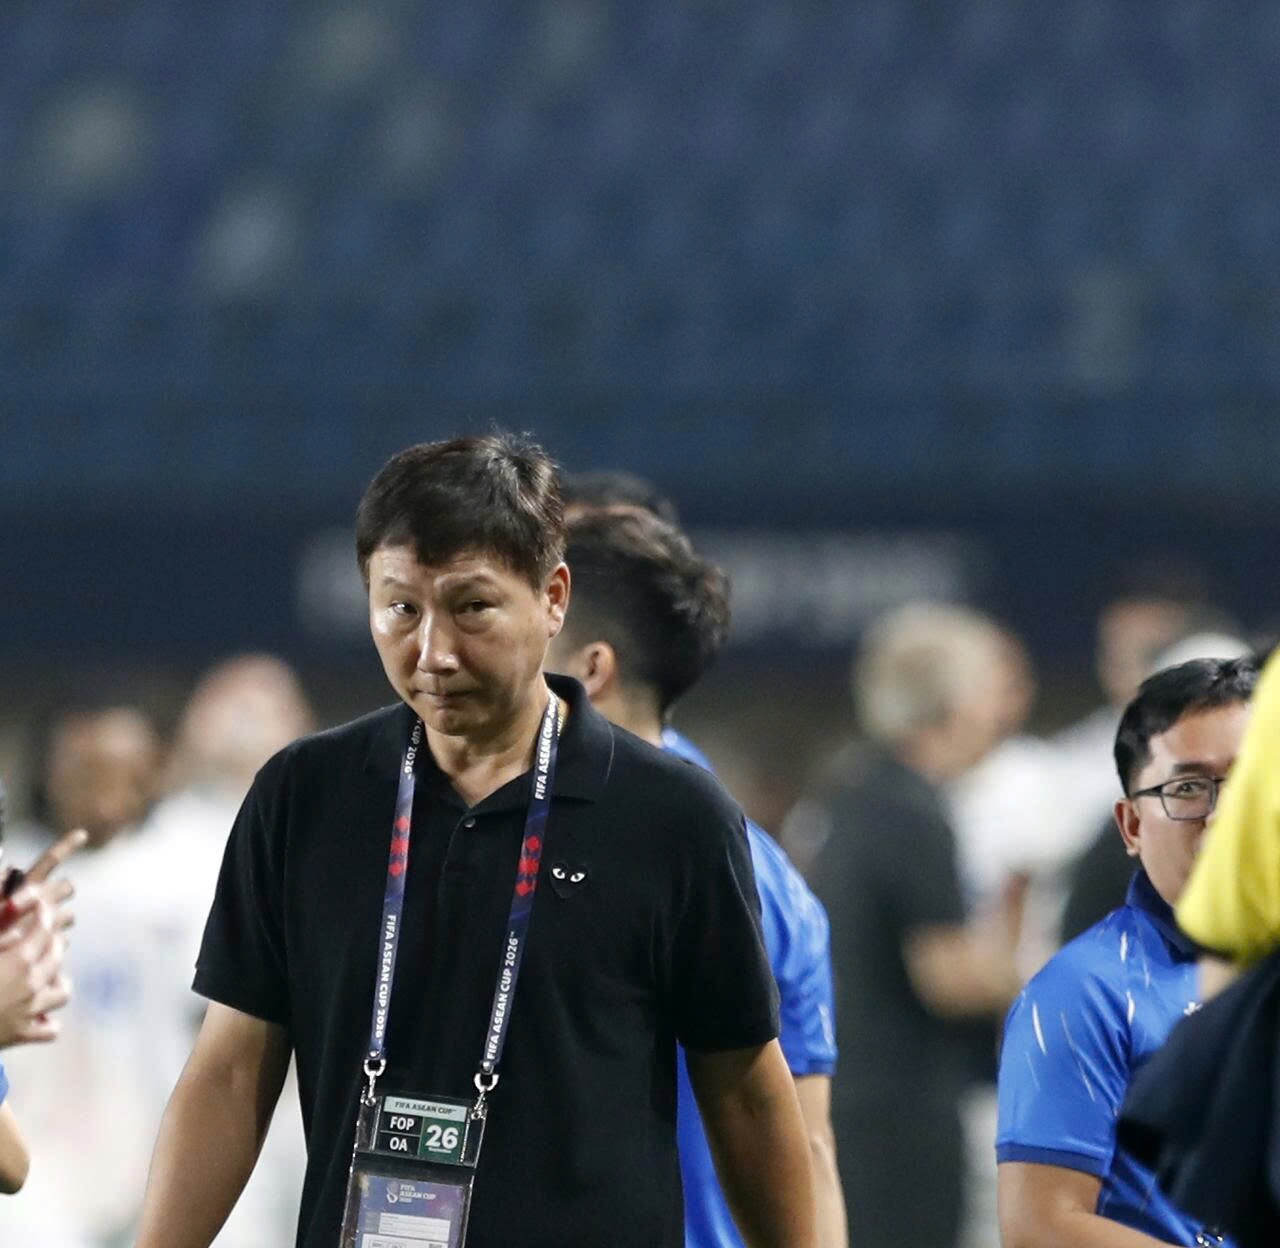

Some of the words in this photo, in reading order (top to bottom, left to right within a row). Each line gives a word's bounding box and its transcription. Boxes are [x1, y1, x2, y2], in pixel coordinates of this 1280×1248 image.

[543, 717, 553, 738] CUP
[538, 737, 551, 773] ASEAN
[535, 775, 547, 800] FIFA
[385, 914, 397, 940] FIFA
[381, 942, 393, 982] ASEAN
[500, 968, 512, 992] CUP
[379, 983, 388, 1008] CUP
[493, 993, 508, 1033] ASEAN
[487, 1035, 499, 1060] FIFA
[395, 1102, 410, 1110] FIFA
[411, 1103, 437, 1113] ASEAN
[390, 1116, 415, 1131] FOP
[389, 1137, 408, 1152] OA
[425, 1124, 459, 1150] 26
